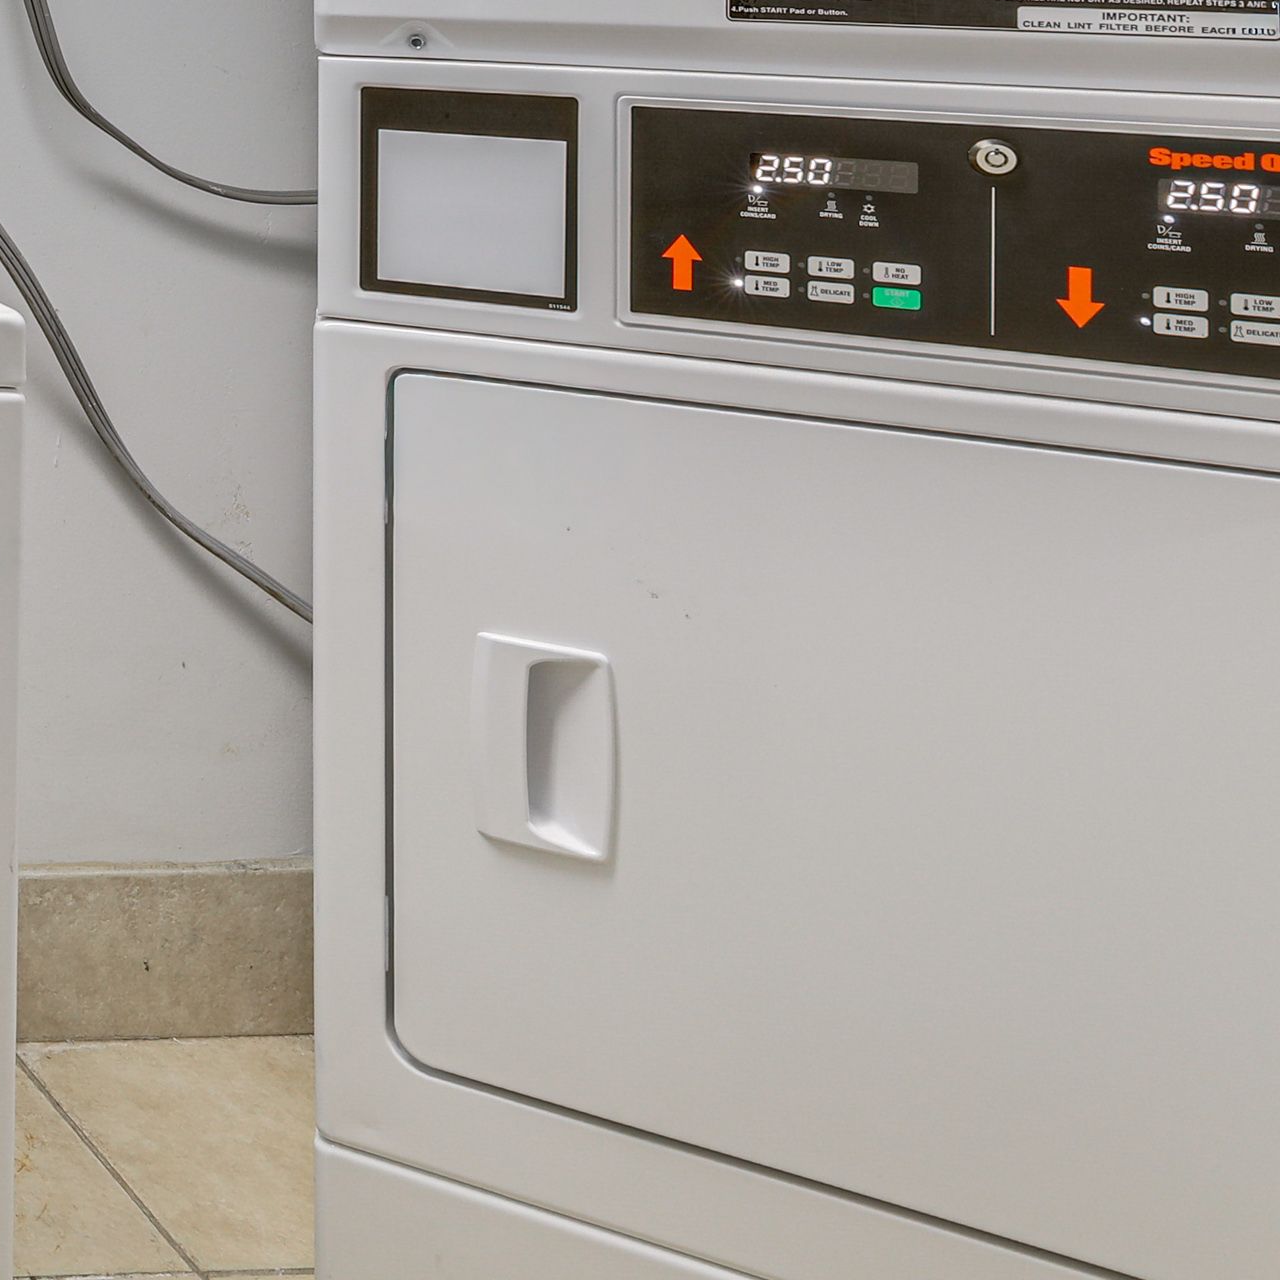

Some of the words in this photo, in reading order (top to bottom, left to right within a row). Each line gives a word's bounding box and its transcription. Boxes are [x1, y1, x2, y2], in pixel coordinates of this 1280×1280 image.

[1101, 11, 1190, 24] IMPORTANT:
[1022, 20, 1061, 30] CLEAN
[1067, 21, 1093, 31] LINT
[1098, 22, 1139, 32] FILTER
[1144, 24, 1195, 34] BEFORE
[1148, 146, 1256, 171] Speed
[755, 154, 833, 185] 2.50
[1166, 179, 1261, 214] 2.50
[1244, 244, 1274, 254] DRYING
[820, 288, 852, 297] DELICATE
